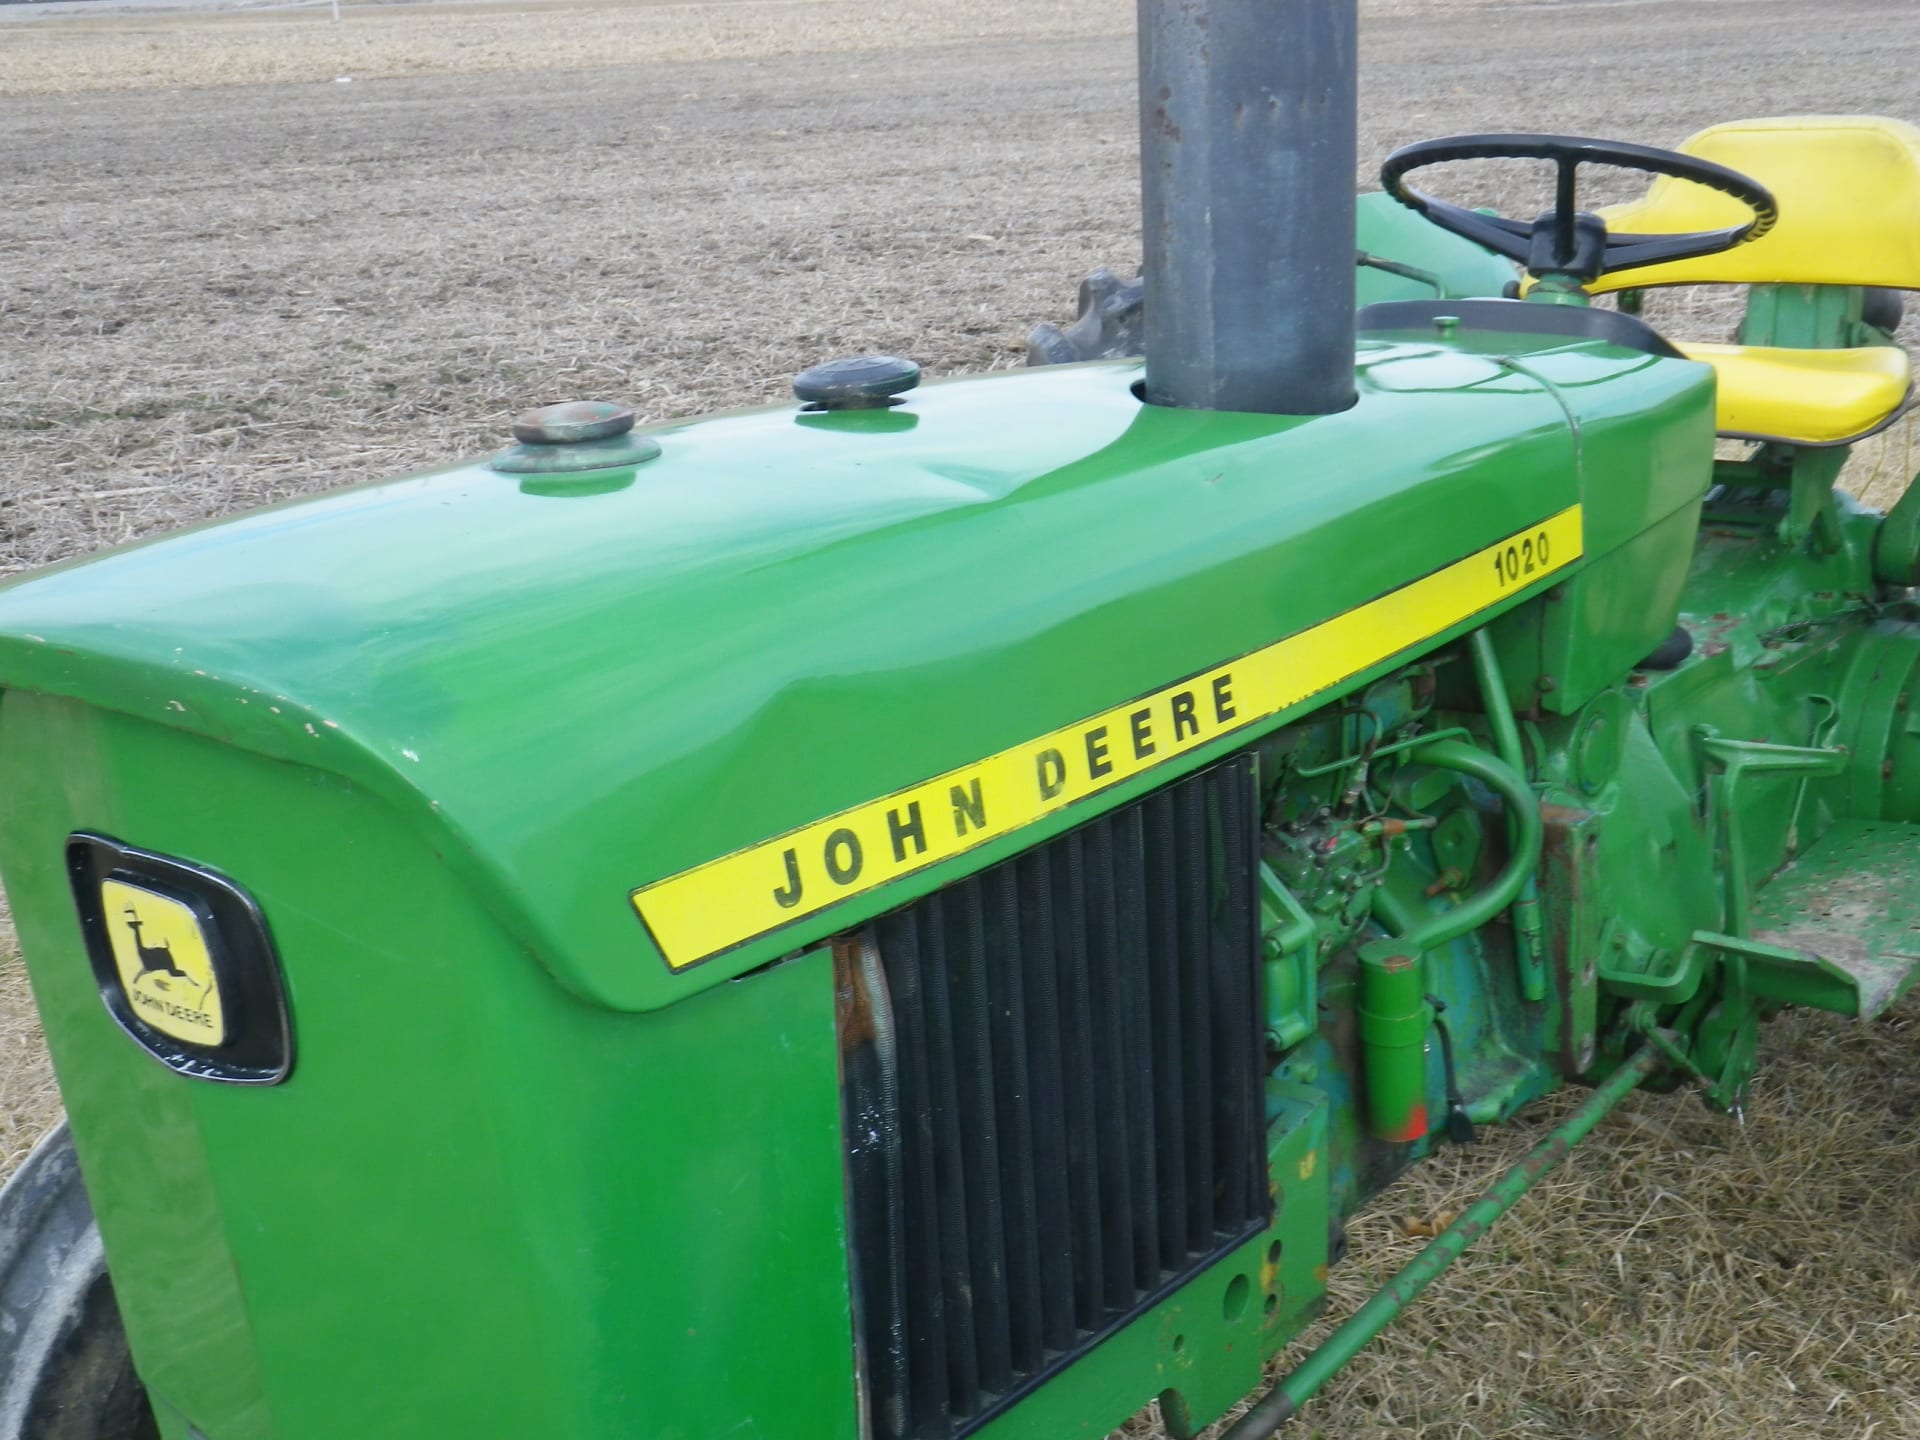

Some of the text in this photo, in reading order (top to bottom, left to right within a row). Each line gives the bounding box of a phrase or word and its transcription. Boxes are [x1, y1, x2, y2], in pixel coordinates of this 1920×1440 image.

[1494, 531, 1549, 587] 1020
[773, 673, 1236, 909] JOHN DEERE
[165, 1001, 213, 1028] DEERE
